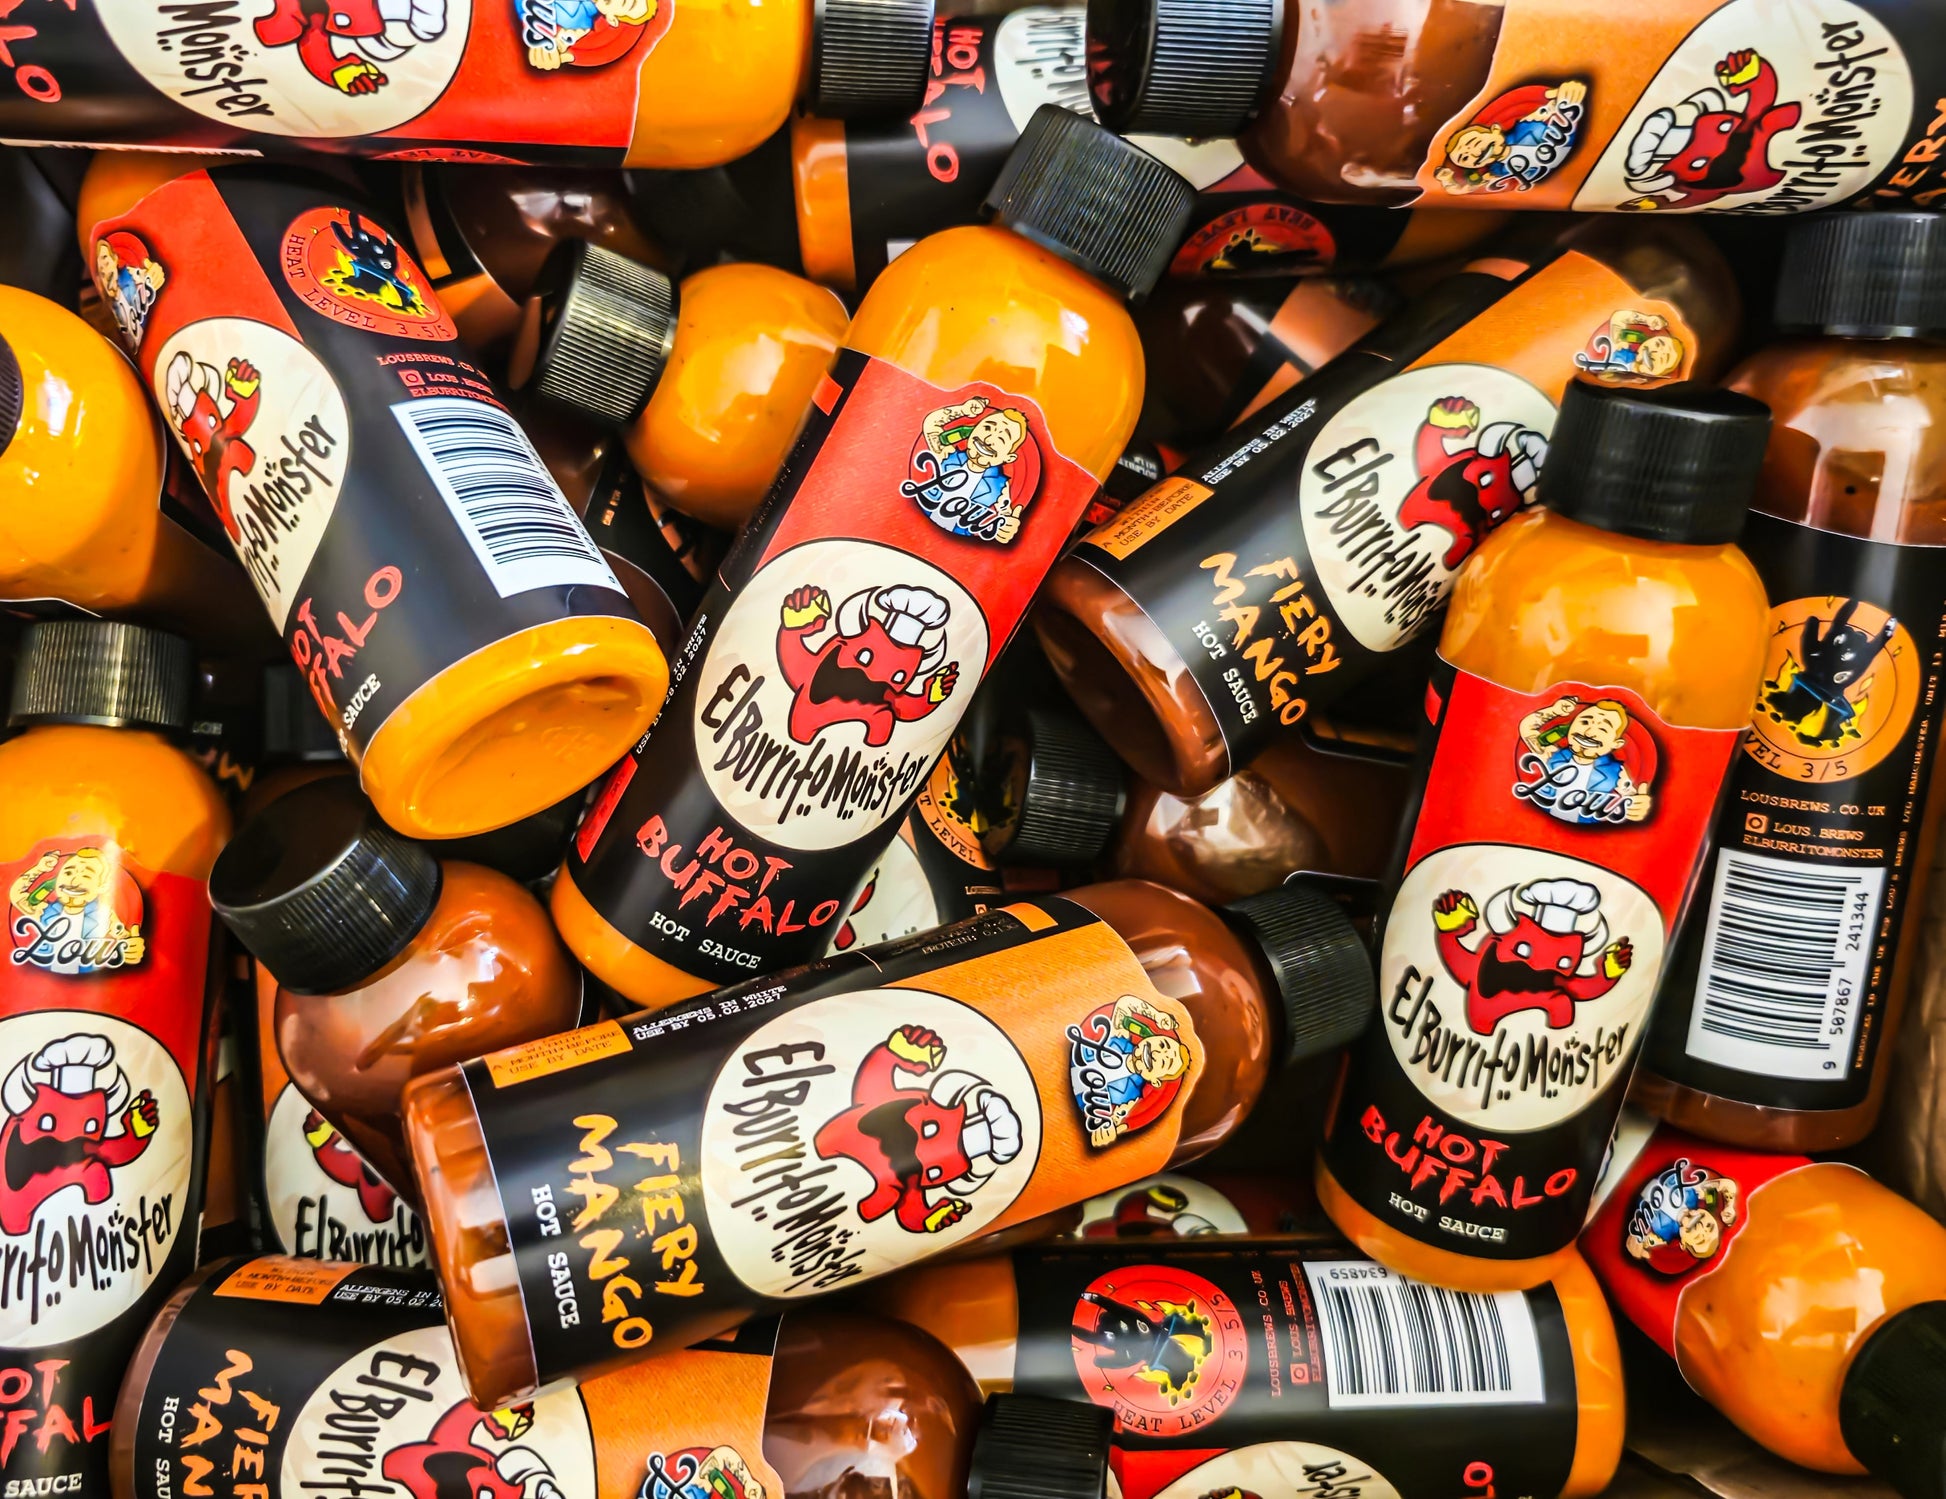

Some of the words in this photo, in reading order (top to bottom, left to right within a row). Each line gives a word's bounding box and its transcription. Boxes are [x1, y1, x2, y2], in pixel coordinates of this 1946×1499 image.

[944, 27, 985, 95] HOT
[286, 233, 306, 280] HEAT
[303, 287, 377, 329] LEVEL
[1207, 467, 1233, 486] USE
[1233, 455, 1250, 468] BY
[1250, 407, 1317, 455] 05.02.2027
[1311, 437, 1395, 494] El
[1119, 530, 1143, 547] USE
[1146, 518, 1162, 530] BY
[1165, 493, 1195, 515] DATE
[290, 598, 323, 673] OT
[1199, 552, 1308, 726] MANGO
[1245, 555, 1343, 677] FIERY
[672, 657, 684, 676] IN
[1191, 620, 1228, 663] HOT
[1222, 666, 1260, 726] SAUCE
[342, 673, 382, 730] SAUCE
[700, 663, 765, 744] El
[1800, 759, 1849, 782] 3/5
[1740, 788, 1887, 817] LOUSBREWS.CO.UK
[696, 825, 795, 888] HOT
[930, 817, 977, 863] LEVEL
[1742, 834, 1884, 859] ELBURRITOMONSTER
[1773, 821, 1864, 842] LOUS.BREWS
[635, 814, 840, 936] BUFFALO
[648, 910, 691, 942] HOT
[697, 937, 762, 970] SAUCE
[1844, 891, 1870, 953] 241344
[632, 1005, 715, 1035] ALLERGENS
[718, 998, 739, 1010] IN
[743, 985, 787, 1003] WHITE
[634, 1025, 665, 1040] USE
[671, 1018, 691, 1031] BY
[697, 992, 783, 1024] 05.02.2027
[1388, 963, 1432, 1039] El
[1829, 976, 1854, 1037] 507867
[507, 1058, 537, 1076] USE
[545, 1052, 567, 1065] BY
[574, 1039, 613, 1060] DATE
[742, 1041, 836, 1087] El
[1822, 1060, 1838, 1071] 9
[1359, 1105, 1578, 1210] BUFFALO
[1413, 1115, 1510, 1177] HOT
[567, 1113, 653, 1349] MANGO
[616, 1139, 704, 1298] FIERY
[1388, 1191, 1429, 1223] HOT
[1438, 1215, 1507, 1242] SAUCE
[530, 1183, 561, 1237] HOT
[547, 1250, 581, 1330] SAUCE
[1329, 1266, 1388, 1280] 634859
[333, 1290, 359, 1301] USE
[361, 1293, 382, 1303] BY
[339, 1284, 410, 1297] ALLERGENS
[415, 1290, 432, 1299] IN
[356, 1350, 441, 1403] El
[1178, 1377, 1237, 1430] LEVEL
[158, 1396, 180, 1444] HOT
[180, 1349, 253, 1497] MAN
[4, 1472, 83, 1498] SAUCE
